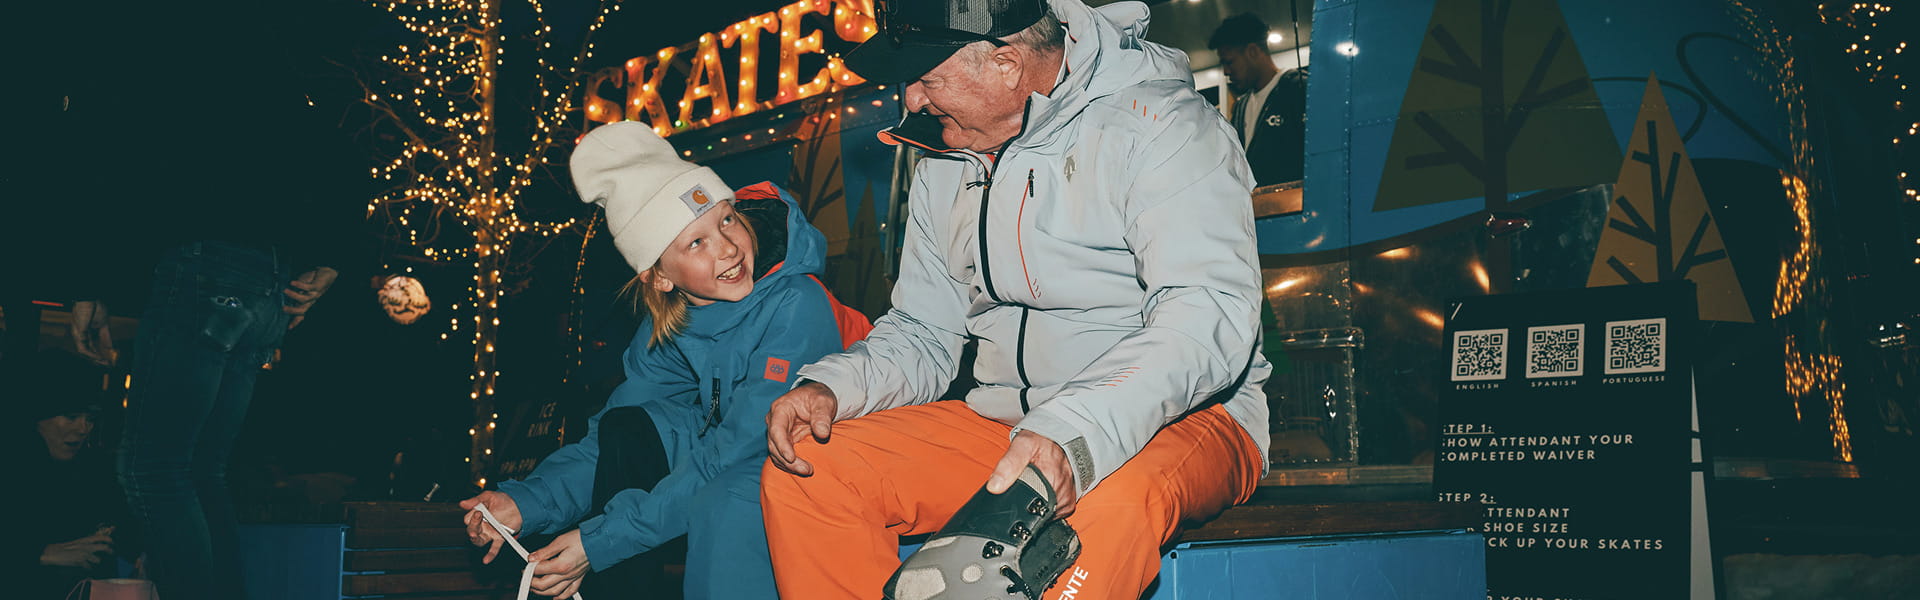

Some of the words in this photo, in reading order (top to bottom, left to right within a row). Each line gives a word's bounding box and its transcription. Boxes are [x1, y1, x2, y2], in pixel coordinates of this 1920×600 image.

[1530, 379, 1578, 388] SPANISH
[1602, 375, 1666, 385] PORTUGUESE
[1455, 383, 1500, 391] ENGLISH
[1442, 437, 1482, 448] HOW
[1488, 435, 1581, 448] ATTENDANT
[1589, 434, 1634, 445] YOUR
[1532, 449, 1596, 461] WAIVER
[1482, 507, 1571, 518] TTENDANT
[1483, 522, 1525, 533] SHOE
[1532, 522, 1569, 534] SIZE
[1516, 537, 1537, 548] UP
[1544, 537, 1590, 549] YOUR
[1598, 538, 1664, 550] SKATES
